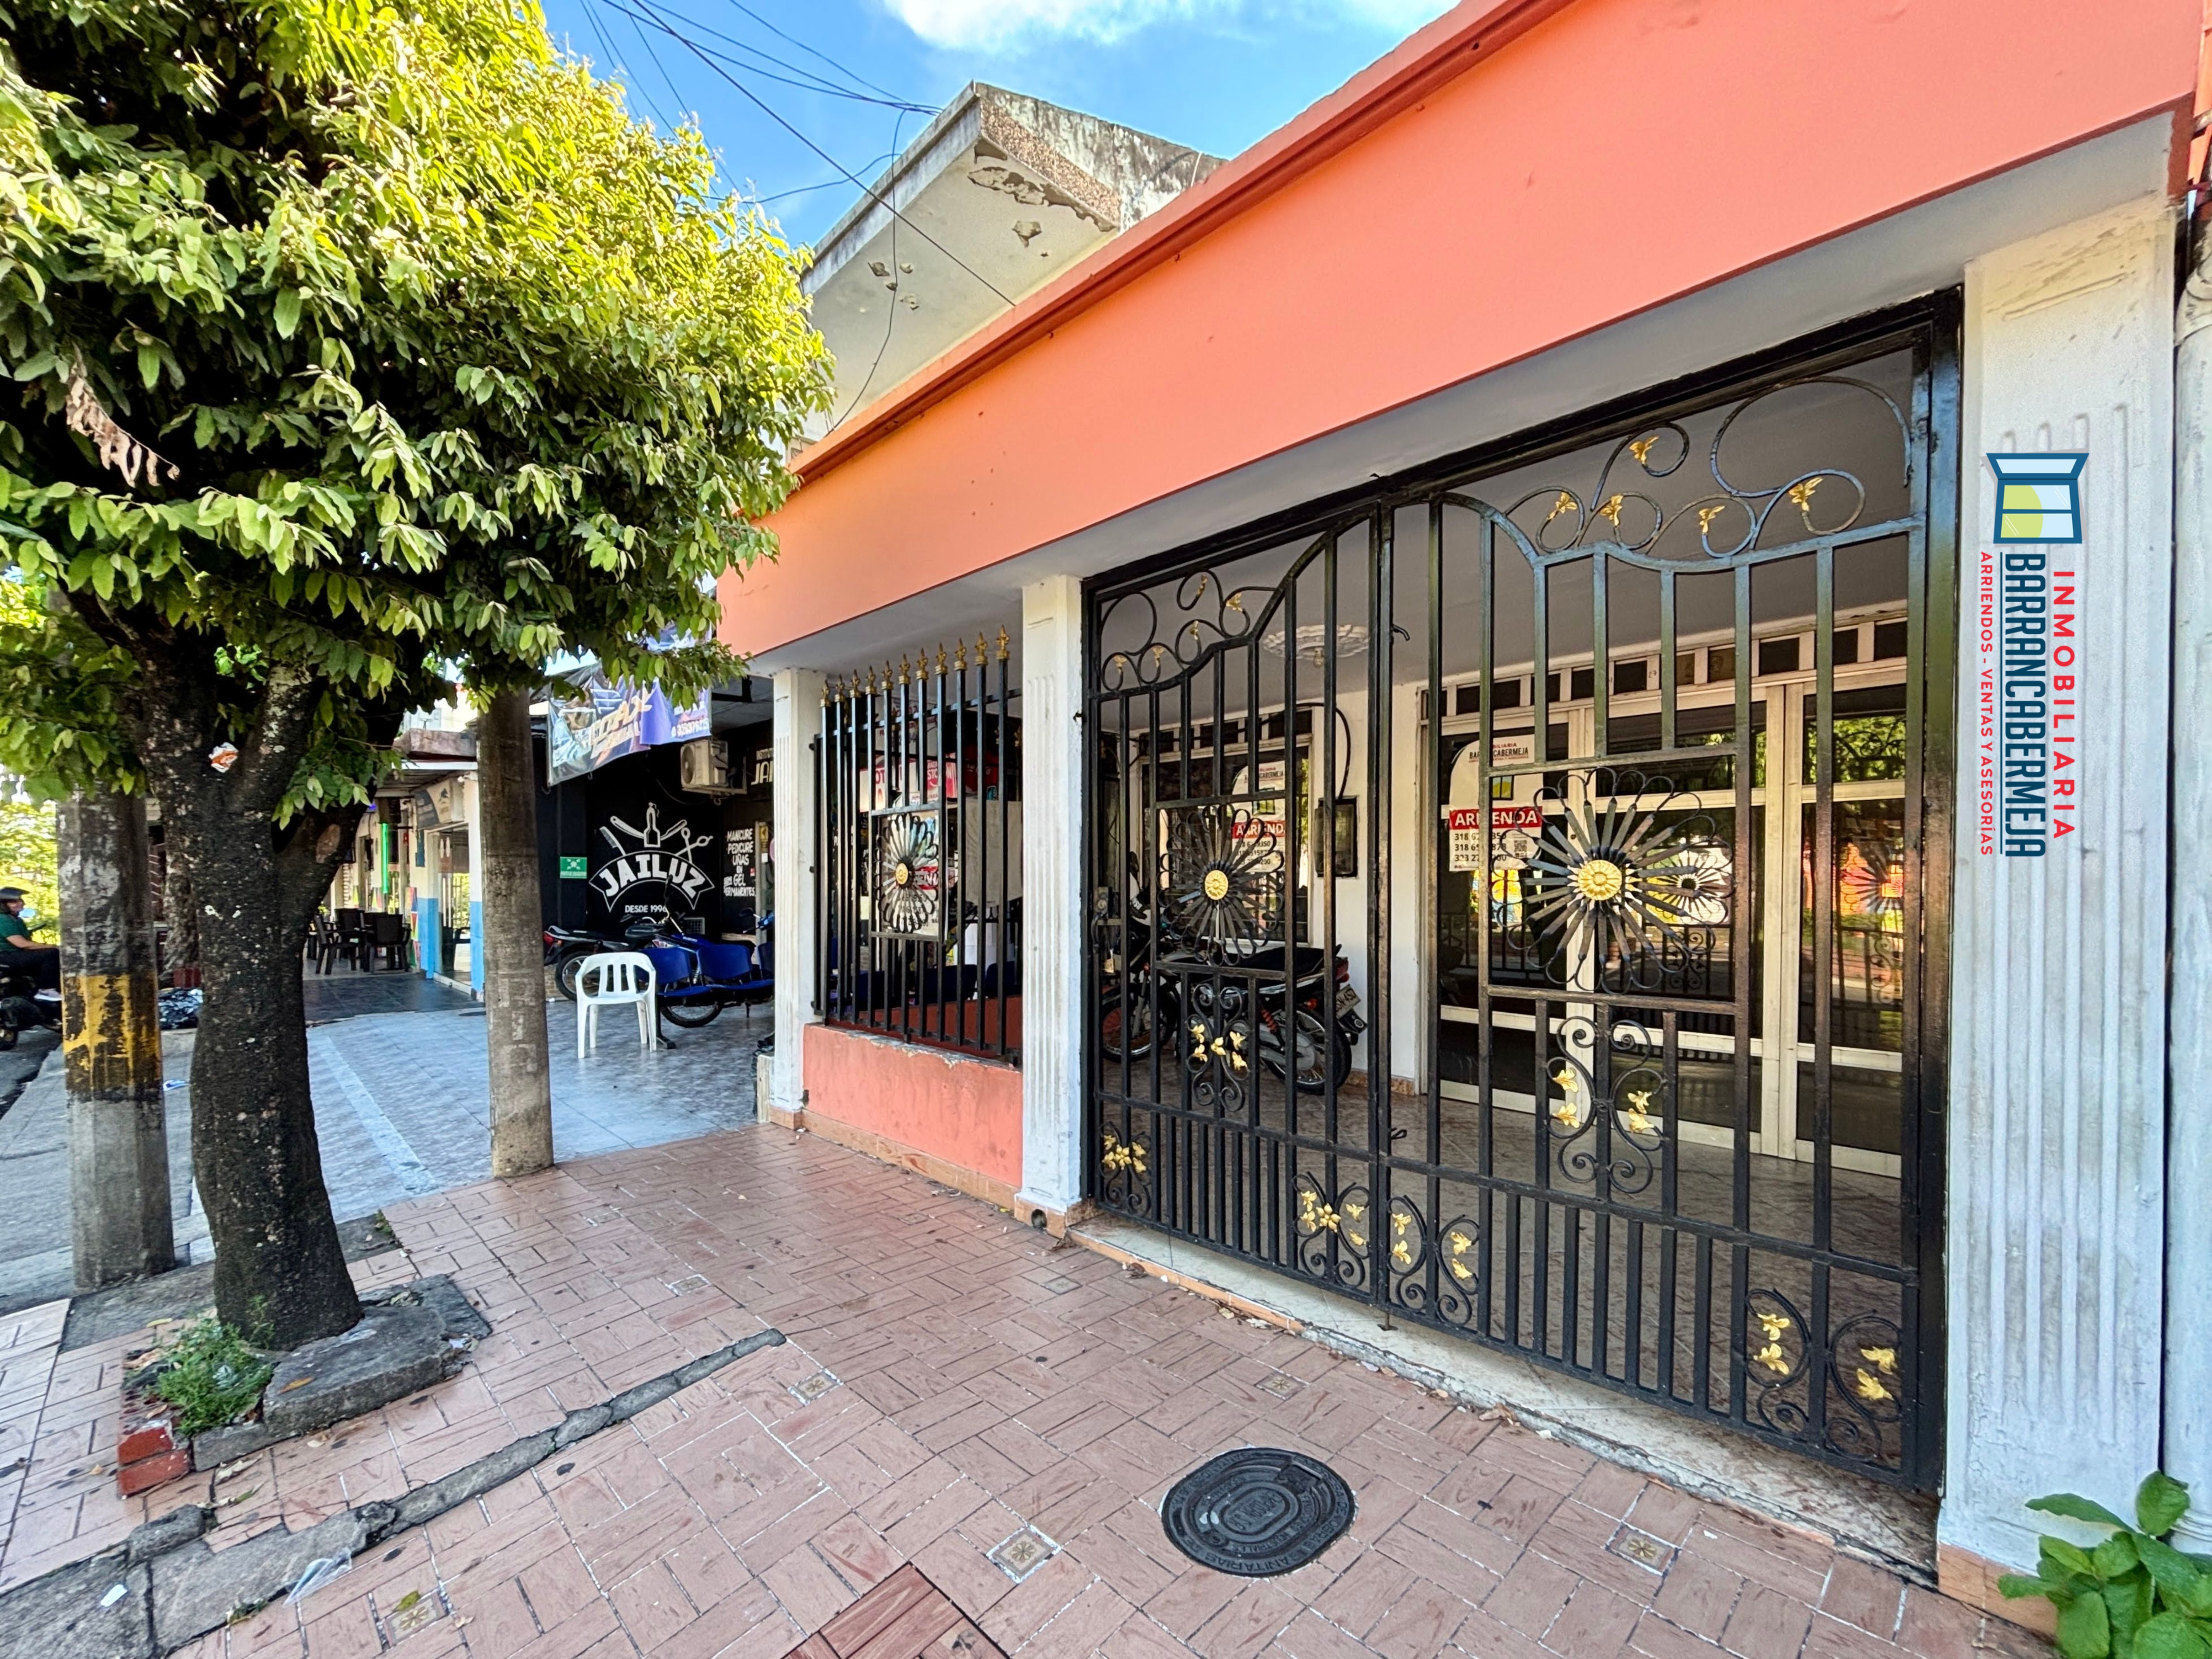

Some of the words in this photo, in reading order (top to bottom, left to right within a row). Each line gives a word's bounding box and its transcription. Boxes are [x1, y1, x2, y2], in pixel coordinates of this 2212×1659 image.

[1455, 810, 1537, 826] ARENDA
[727, 828, 753, 842] MANICURE
[727, 841, 754, 855] PEDICURE
[732, 853, 749, 866] UÑAS
[599, 854, 706, 899] JAILUZ
[733, 874, 746, 886] GEL
[1203, 1549, 1302, 1572] SANITARIAS
